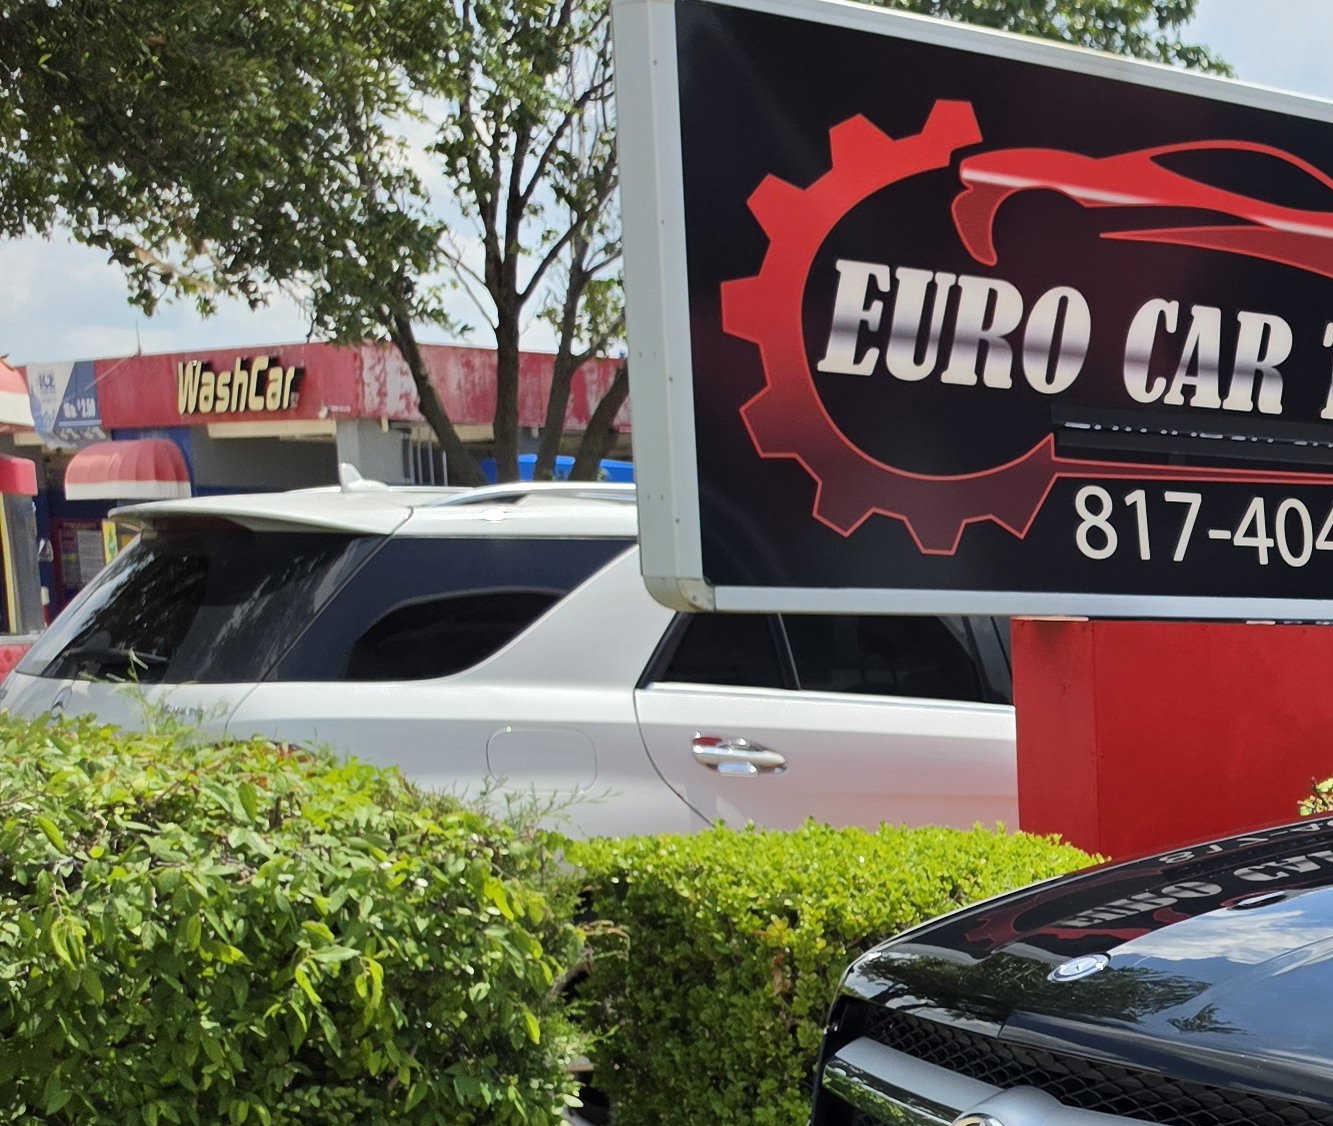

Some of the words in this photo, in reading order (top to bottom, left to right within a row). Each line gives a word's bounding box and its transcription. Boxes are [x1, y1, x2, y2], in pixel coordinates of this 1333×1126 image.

[177, 354, 296, 416] WashCar
[816, 259, 1092, 393] EURO
[1122, 297, 1294, 415] CAR
